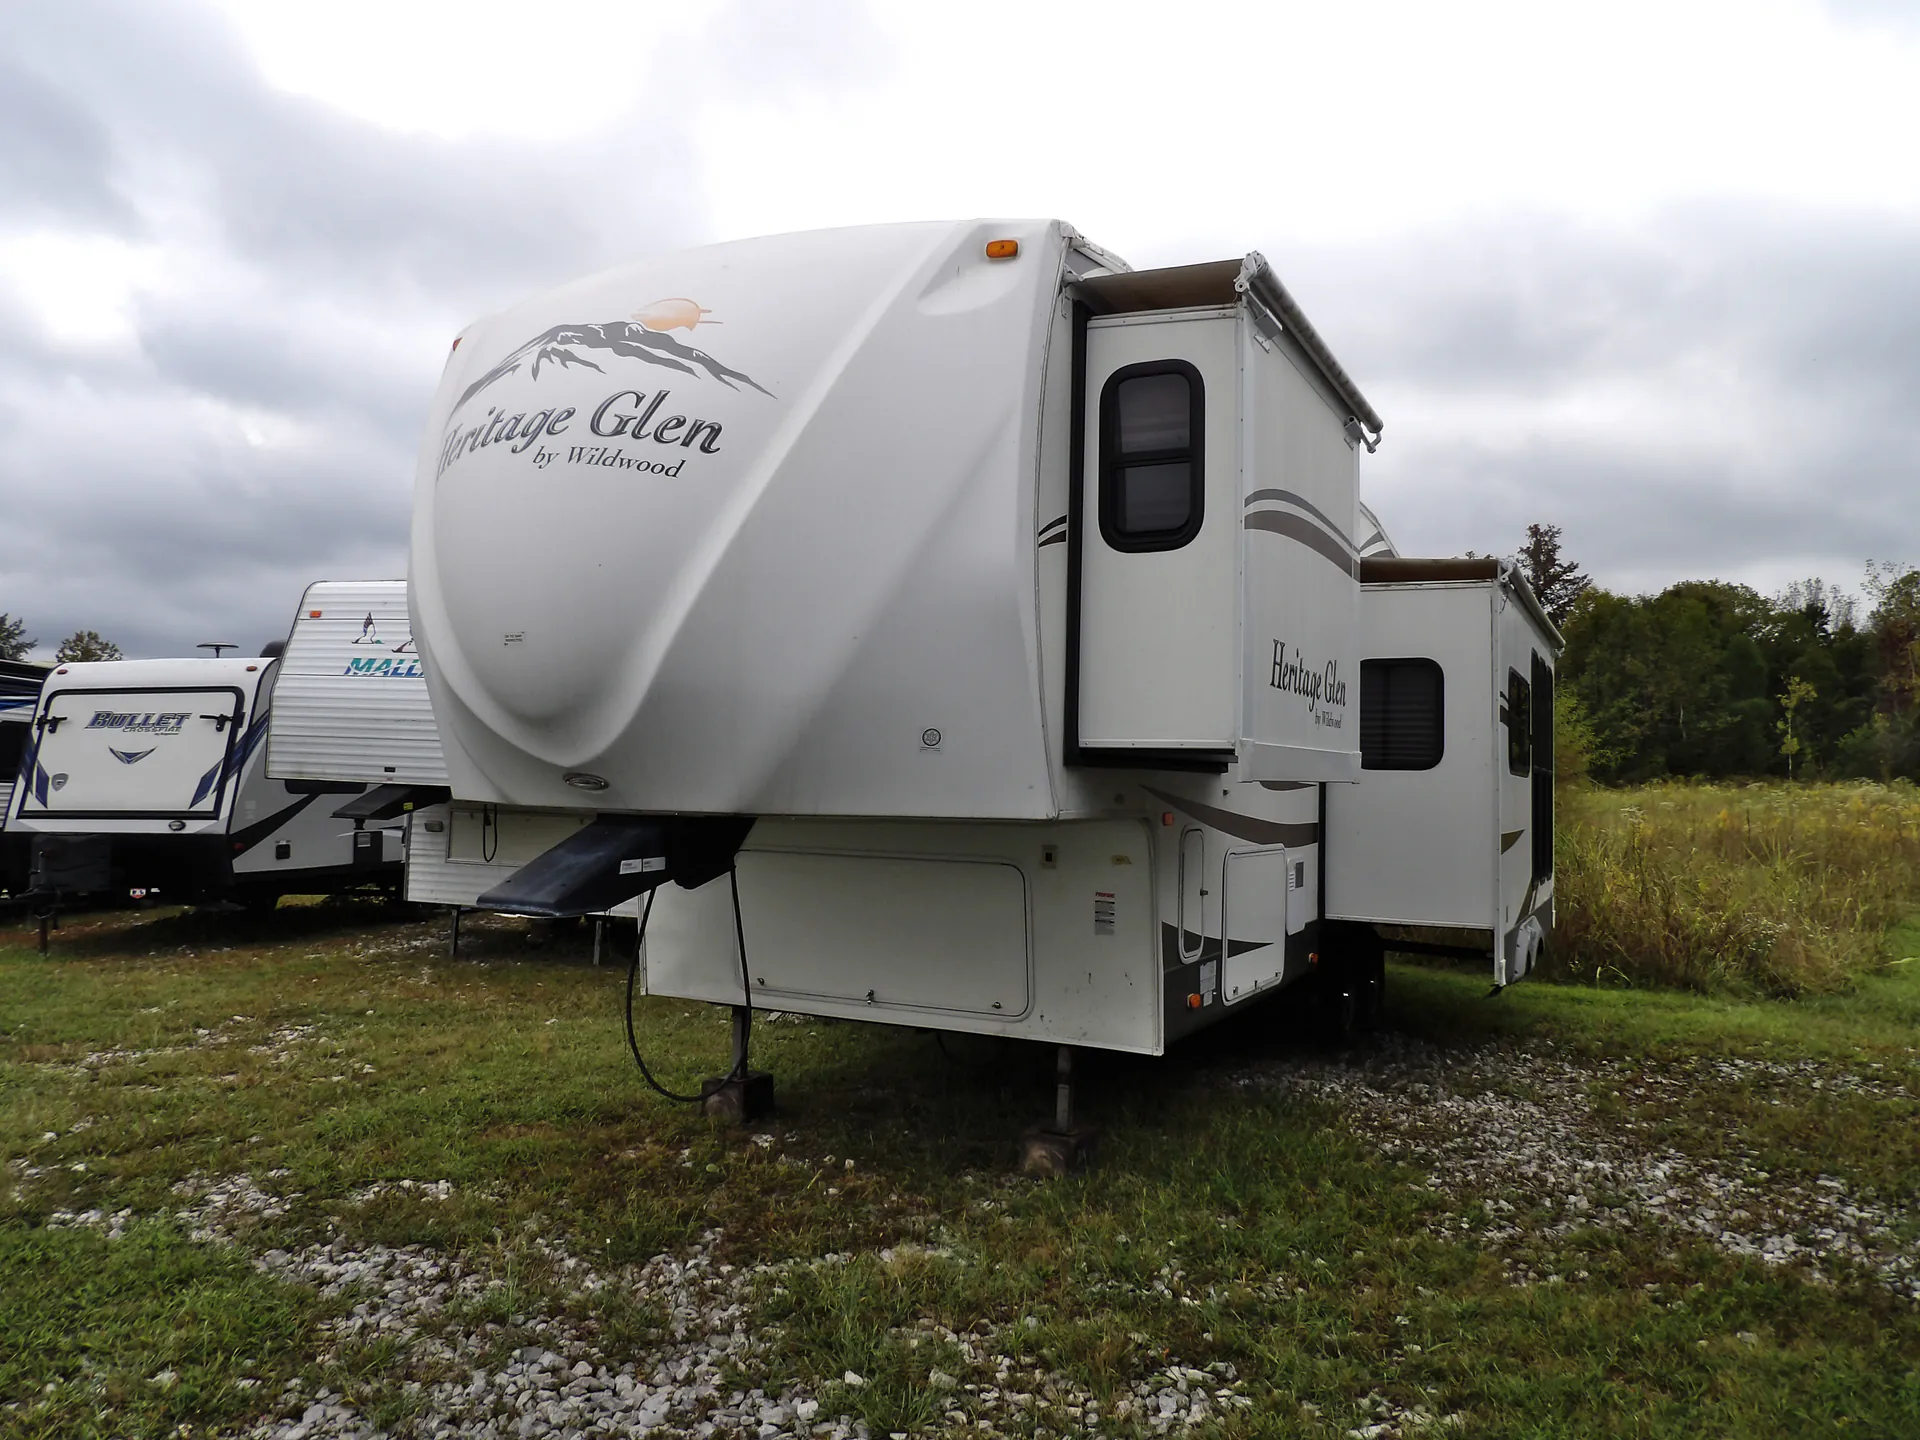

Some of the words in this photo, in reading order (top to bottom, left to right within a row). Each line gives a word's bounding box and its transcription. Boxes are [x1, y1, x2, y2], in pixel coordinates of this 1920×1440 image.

[437, 406, 577, 477] Heritage
[590, 389, 723, 454] Glen
[532, 445, 561, 470] by
[567, 446, 687, 479] Wildwood
[344, 657, 424, 677] MALL
[1269, 638, 1322, 713] Heritage
[1324, 659, 1347, 708] Glen
